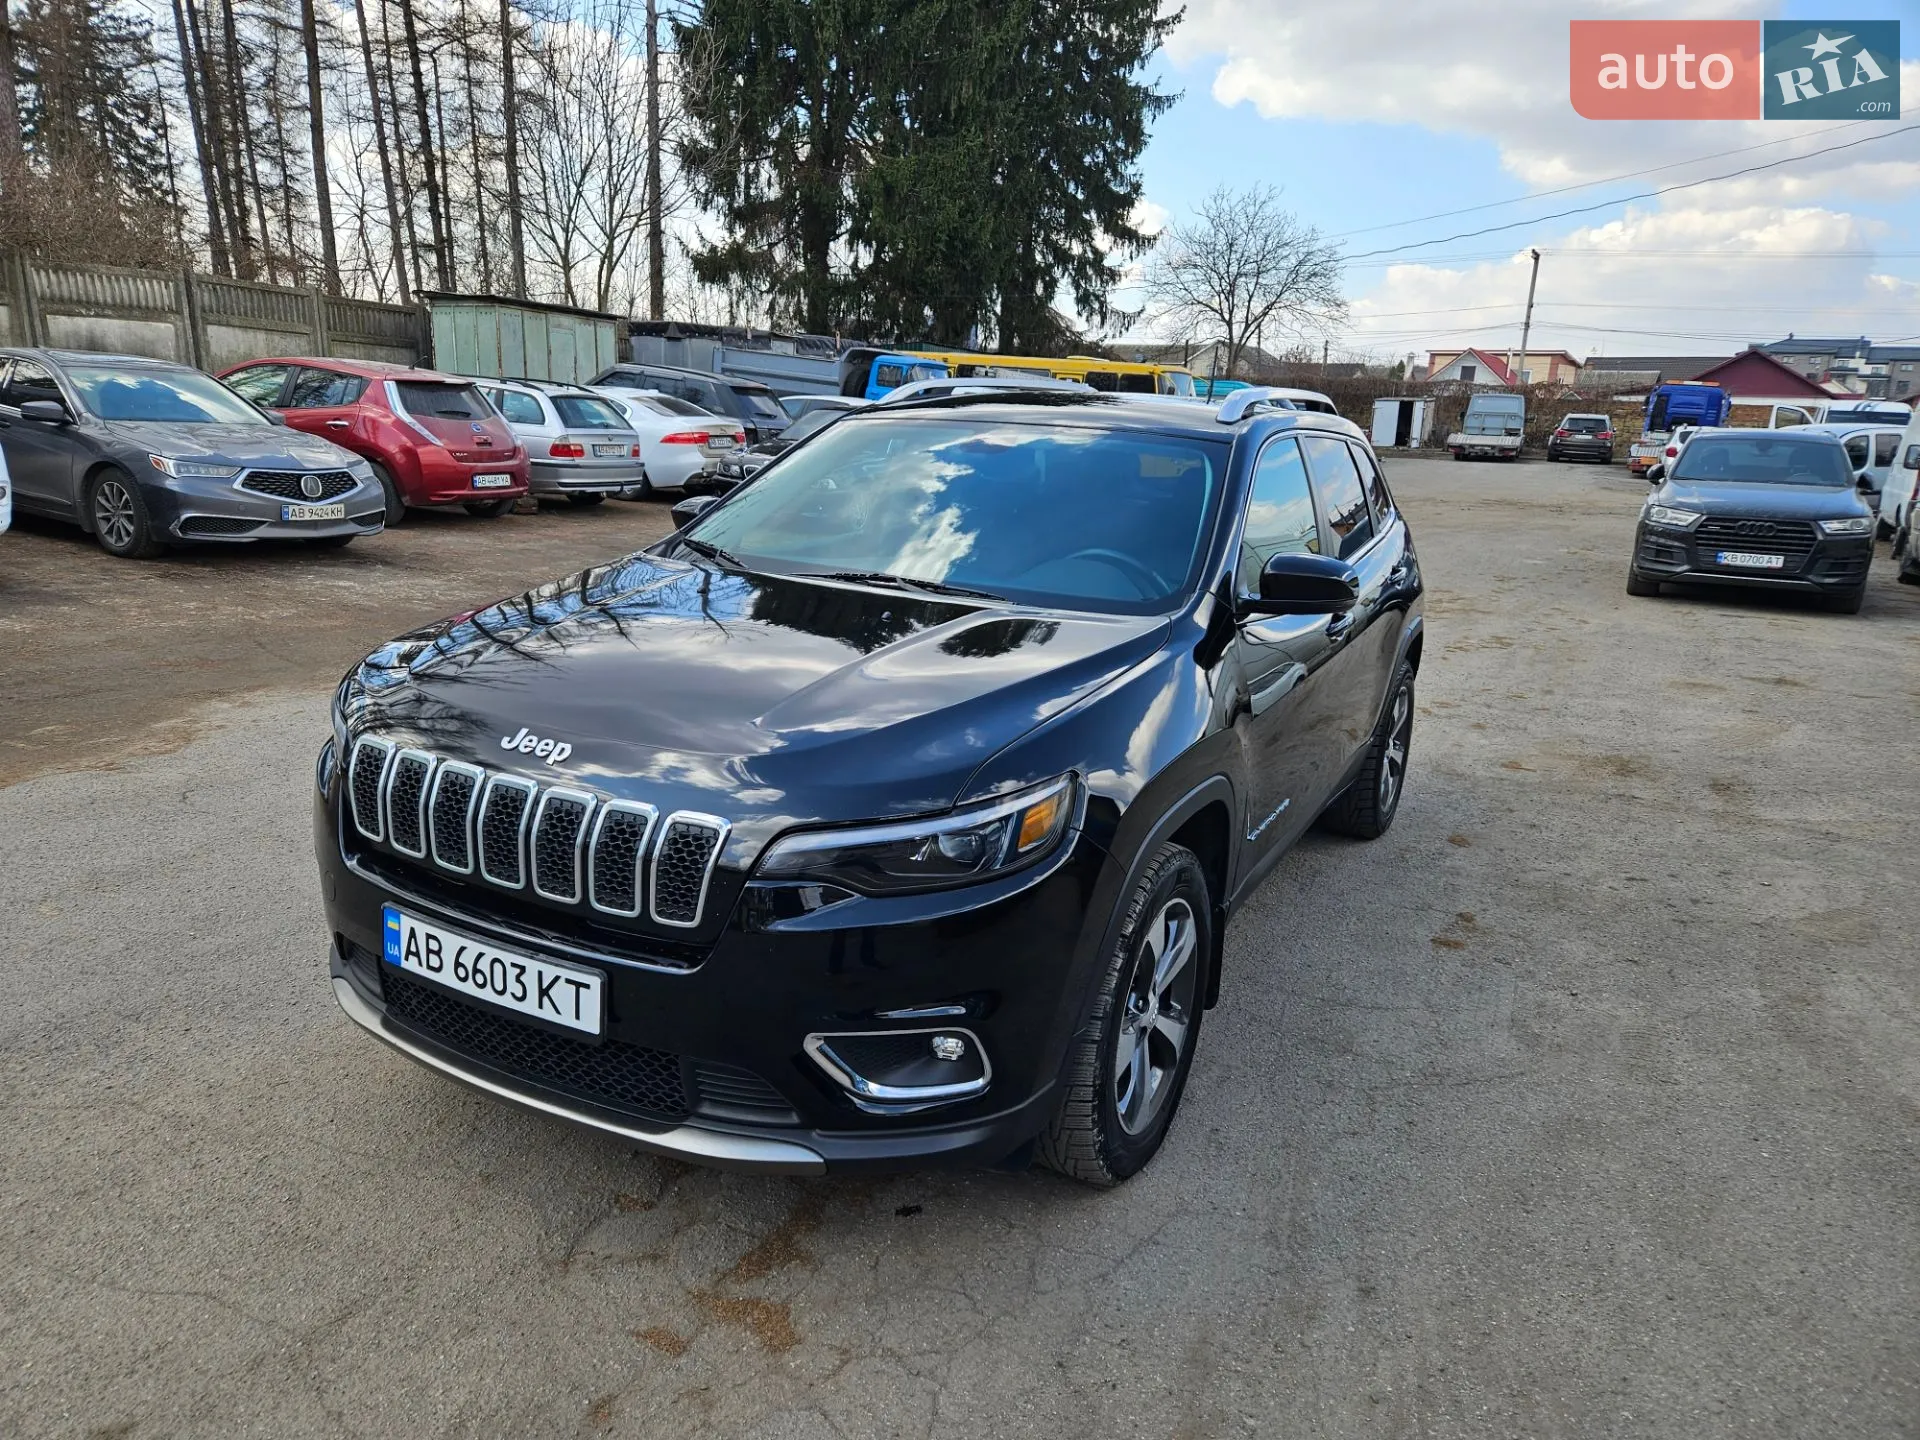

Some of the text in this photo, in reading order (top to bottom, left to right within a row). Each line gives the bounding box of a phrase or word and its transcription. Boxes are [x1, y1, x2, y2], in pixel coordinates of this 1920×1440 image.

[290, 507, 342, 518] AB 9424 KH
[1723, 553, 1782, 565] KB 0700 AT
[500, 727, 572, 766] Jeep
[387, 941, 400, 958] UA
[404, 926, 591, 1021] AB 6603 KT
